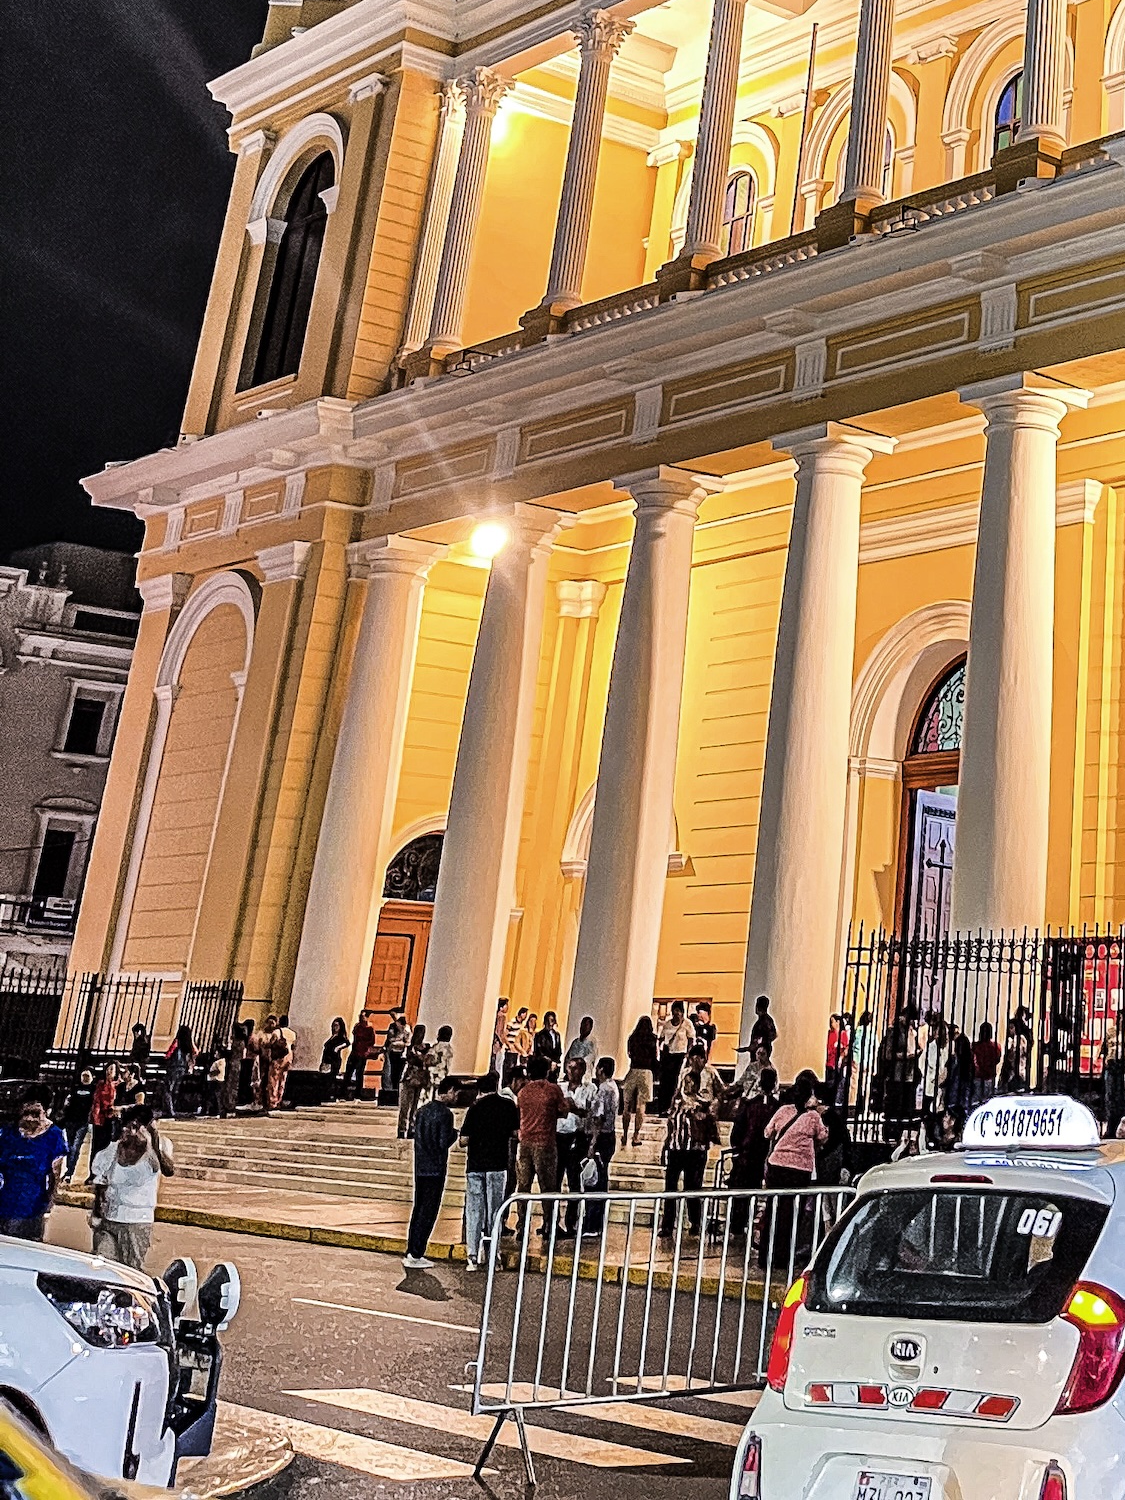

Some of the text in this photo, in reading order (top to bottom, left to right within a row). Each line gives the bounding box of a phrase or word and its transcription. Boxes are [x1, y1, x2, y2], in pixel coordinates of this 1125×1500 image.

[994, 1108, 1064, 1137] 981879651
[1016, 1208, 1062, 1237] 061
[893, 1340, 917, 1358] KIA
[891, 1391, 910, 1403] KIA
